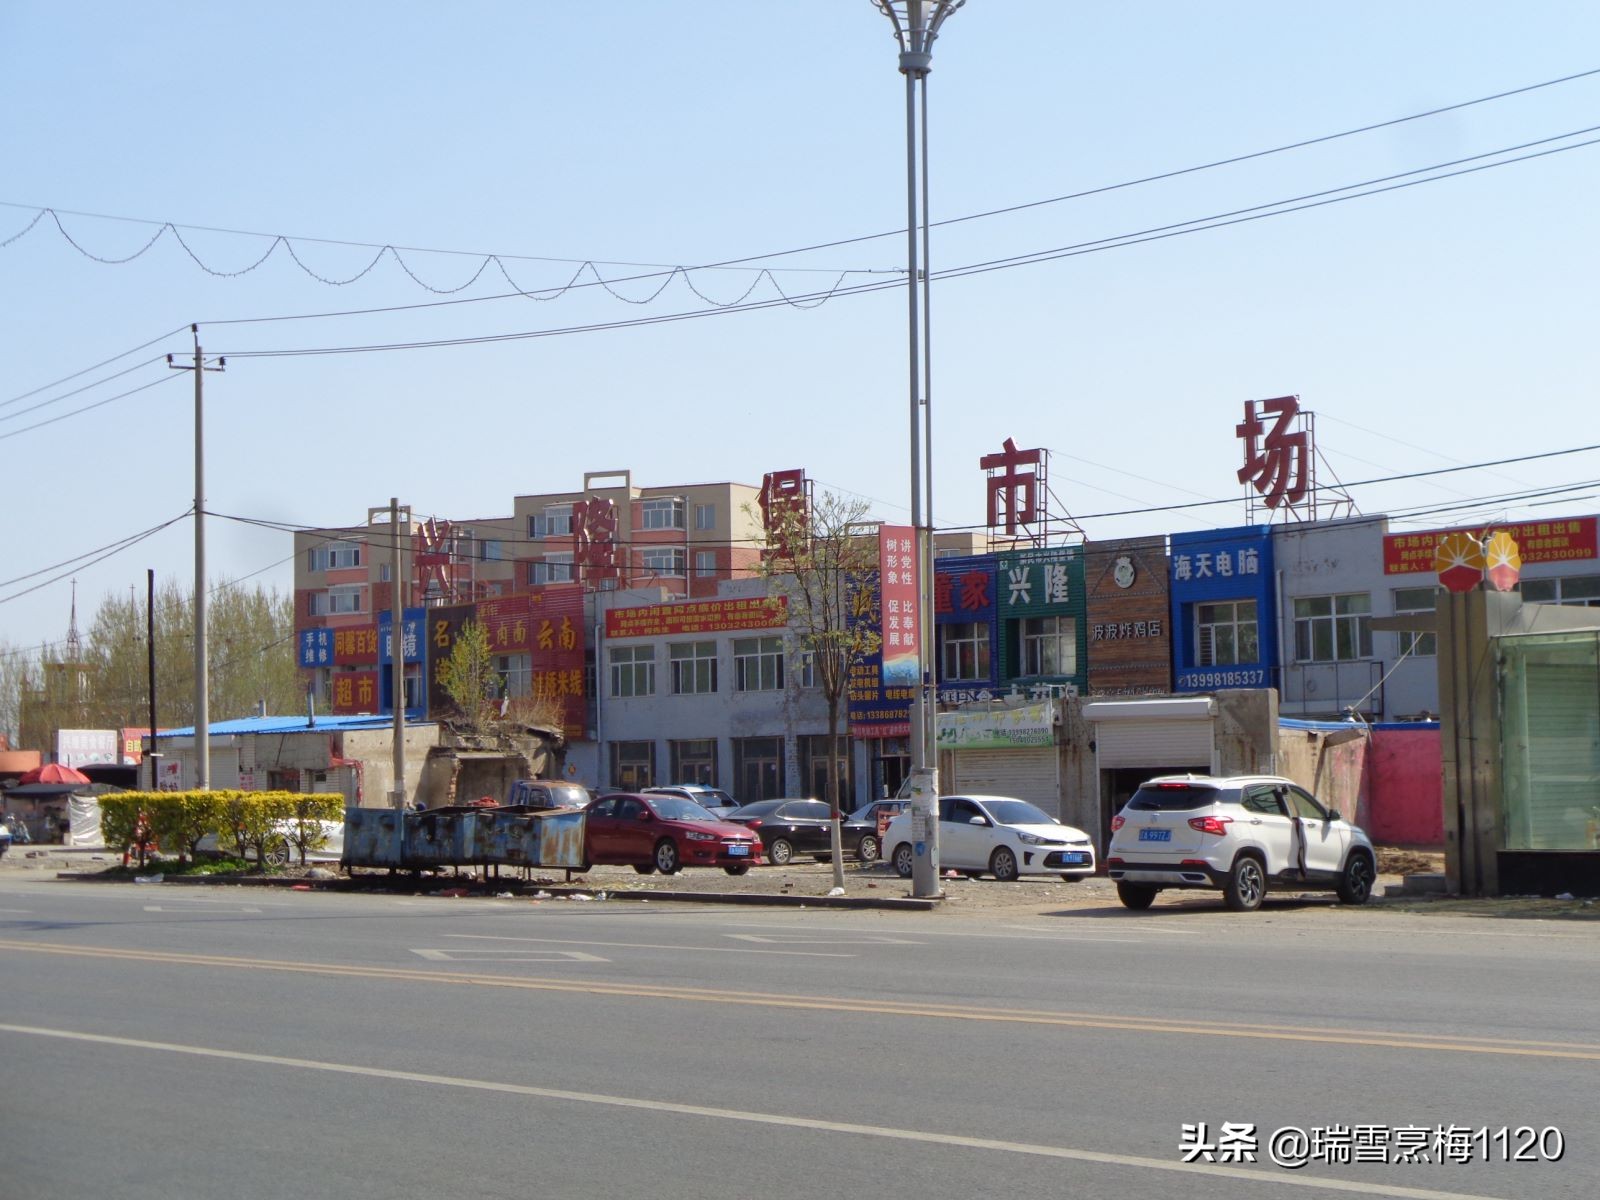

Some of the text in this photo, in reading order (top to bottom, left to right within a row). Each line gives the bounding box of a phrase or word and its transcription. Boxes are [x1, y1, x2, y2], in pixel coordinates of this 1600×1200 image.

[1174, 549, 1259, 581] 海天电脑
[886, 538, 900, 646] 树形象 促发展
[900, 539, 914, 646] 讲党性 比奉献
[1008, 563, 1069, 606] 兴隆
[305, 631, 328, 648] 手机
[537, 615, 577, 650] 云南
[1092, 620, 1162, 641] 波波炸鸡店
[305, 648, 328, 663] 维修
[336, 675, 373, 707] 超市
[1186, 670, 1264, 688] 13998185337
